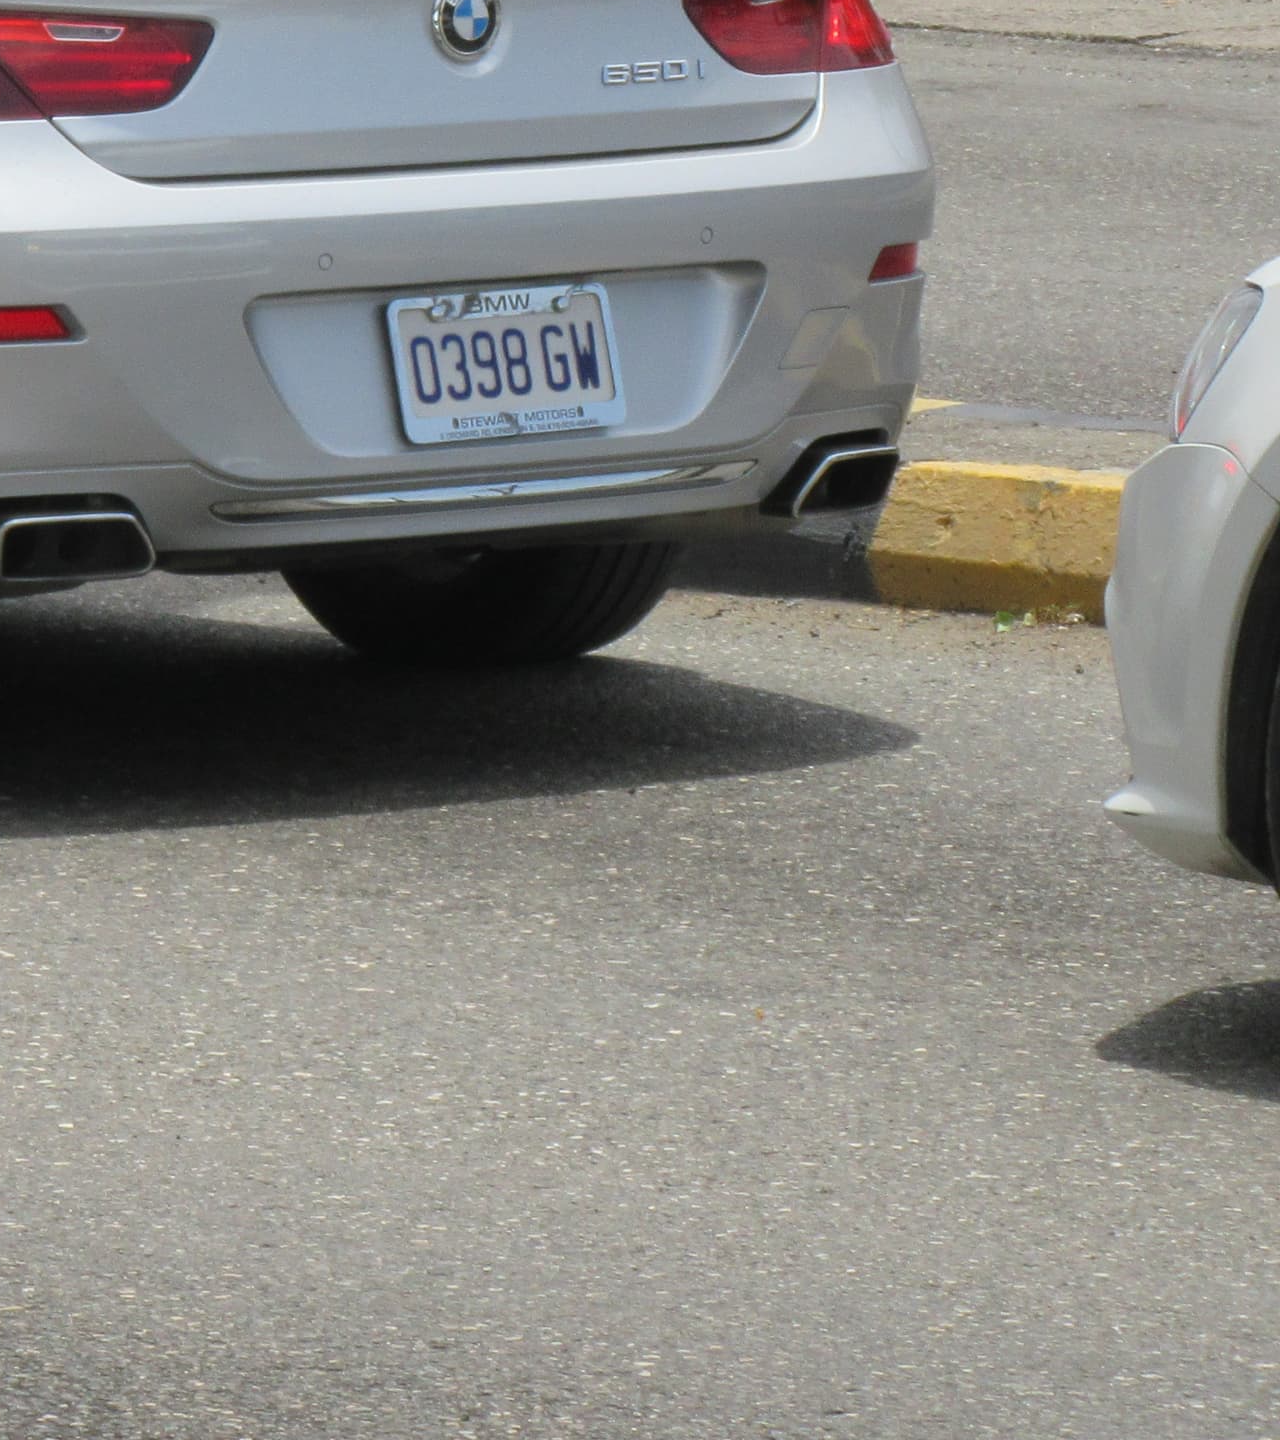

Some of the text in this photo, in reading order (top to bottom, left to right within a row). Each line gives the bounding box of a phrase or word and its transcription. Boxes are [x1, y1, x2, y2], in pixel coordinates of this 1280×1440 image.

[410, 321, 600, 404] 0398 GW
[460, 407, 577, 429] STEWAT MOTORS
